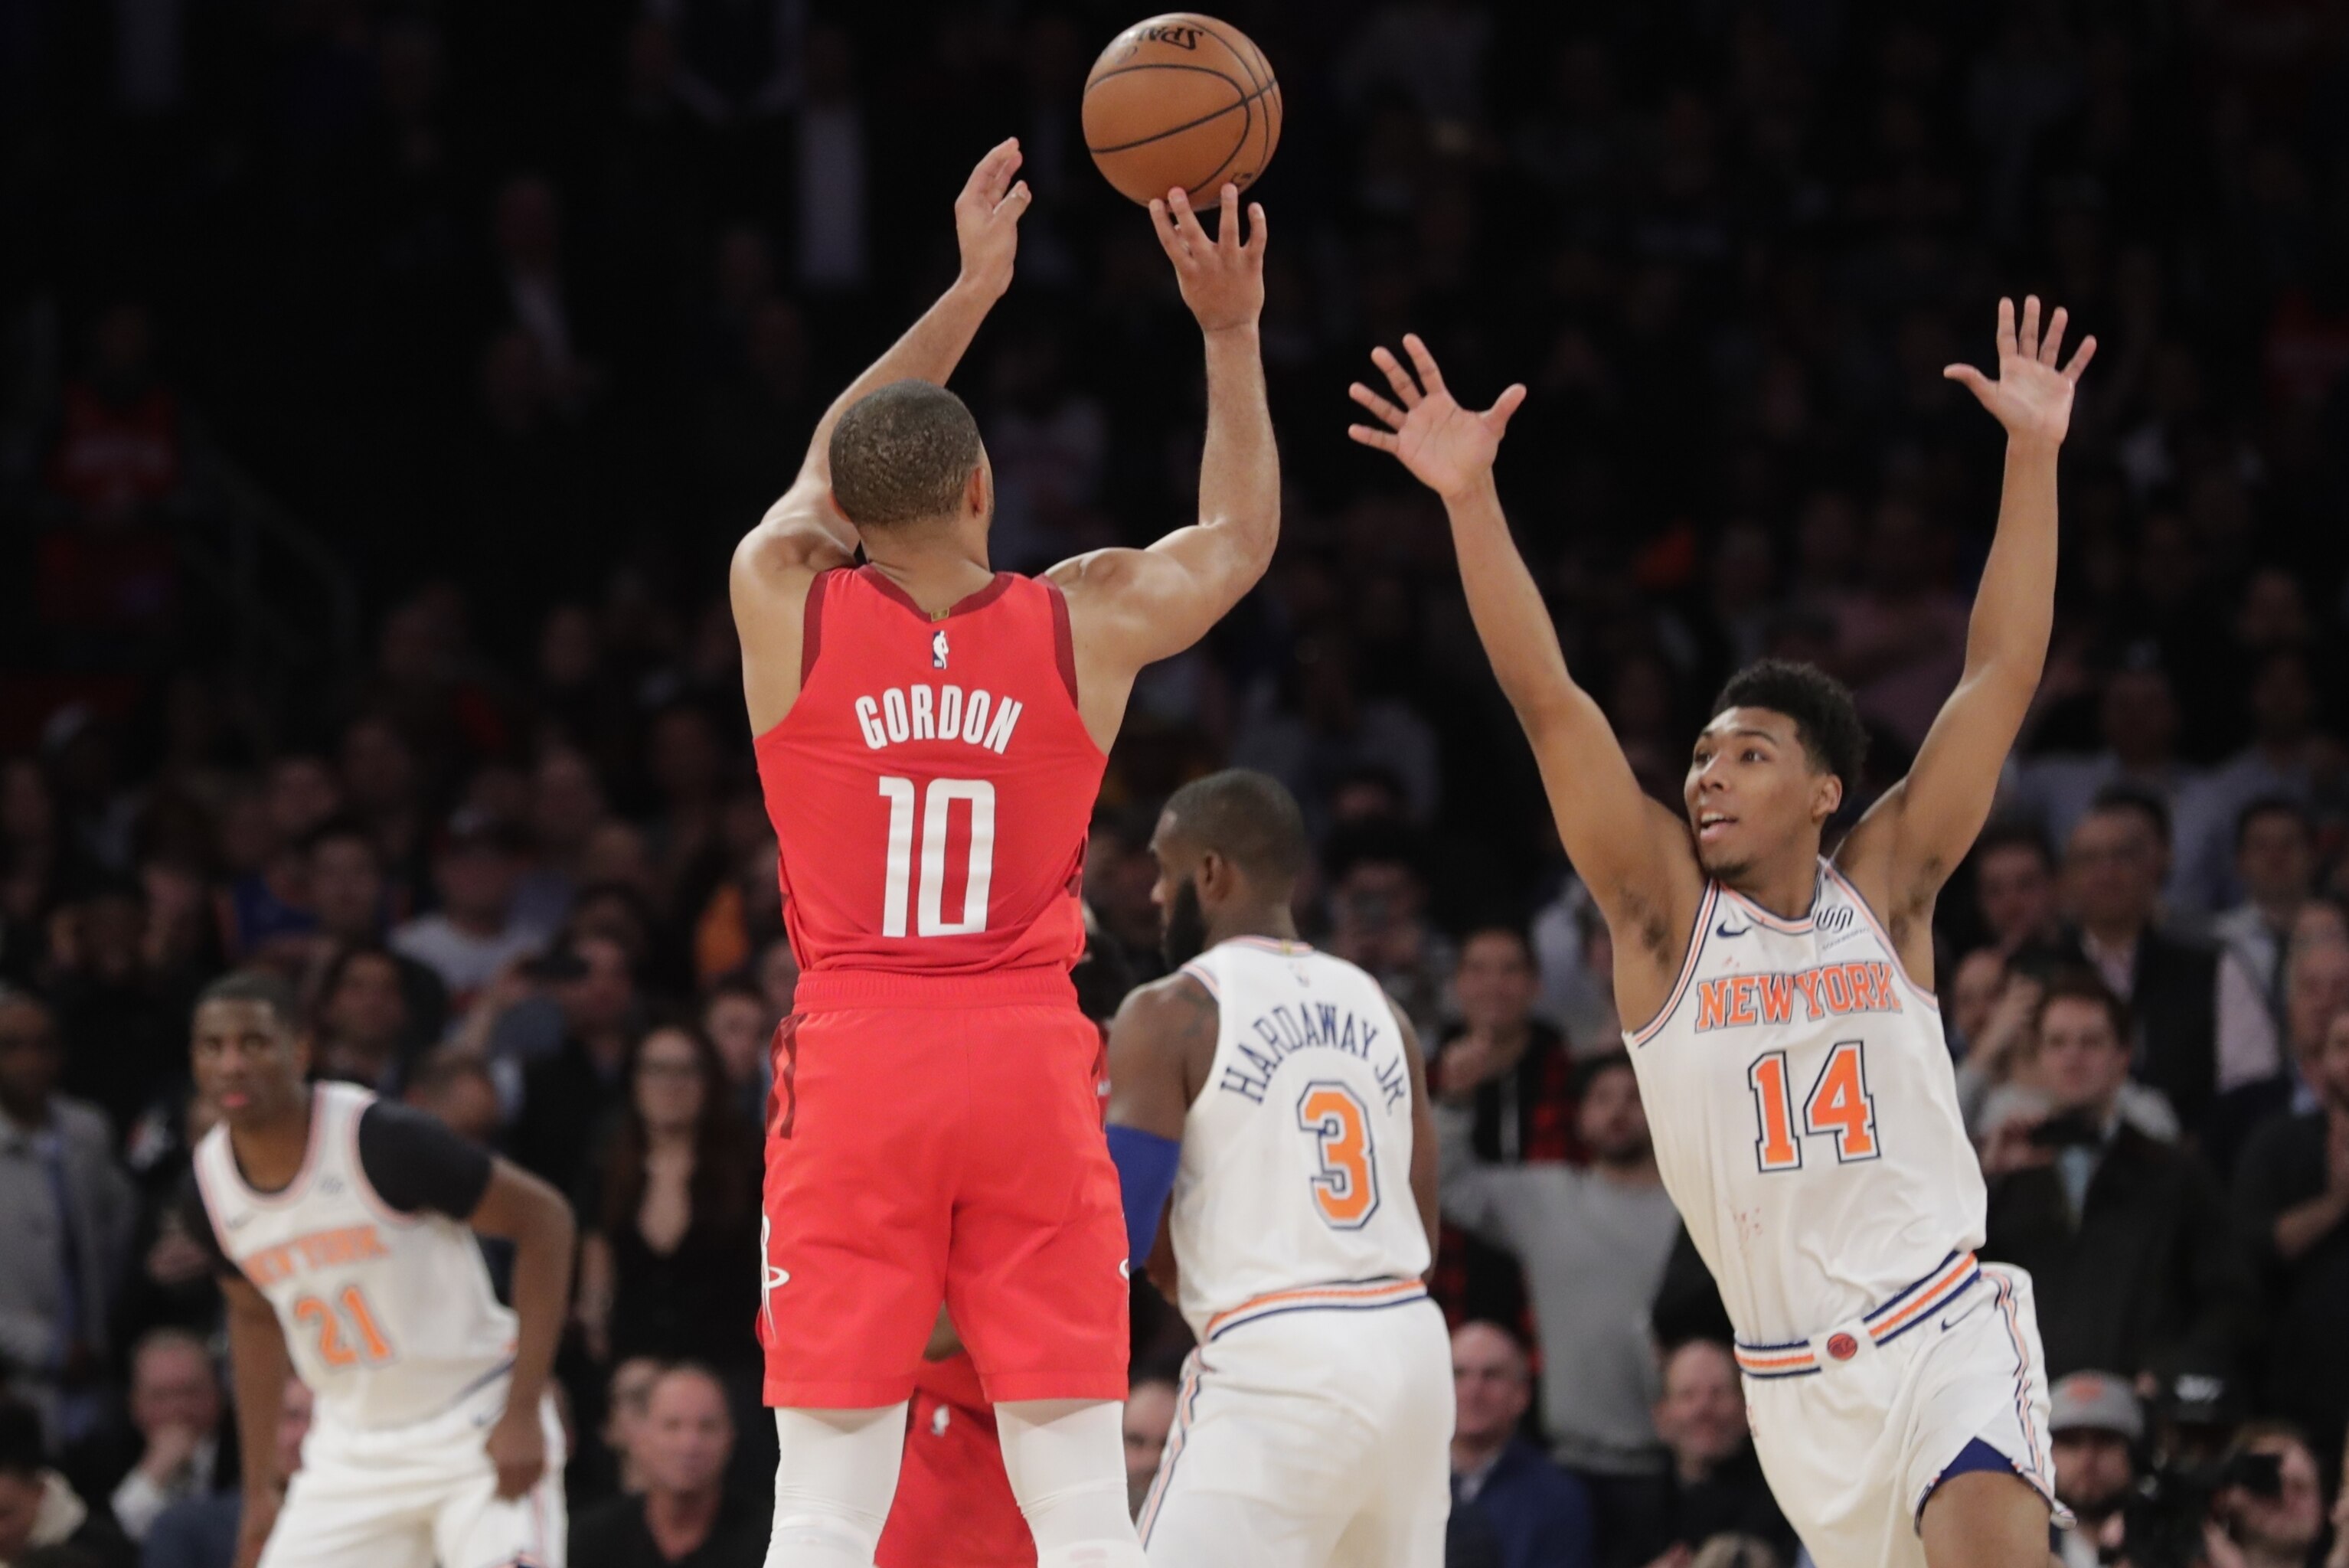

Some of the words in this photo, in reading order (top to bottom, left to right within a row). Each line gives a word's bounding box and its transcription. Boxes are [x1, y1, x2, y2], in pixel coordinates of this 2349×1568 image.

[854, 684, 1023, 755] GORDON
[878, 776, 995, 938] 10
[1695, 972, 1795, 1034] NEW
[1795, 961, 1903, 1022] YORK
[1220, 1001, 1377, 1105] HARDAWAY
[1296, 1080, 1380, 1230] 3
[1747, 1040, 1881, 1173] 14
[292, 1286, 393, 1369] 21
